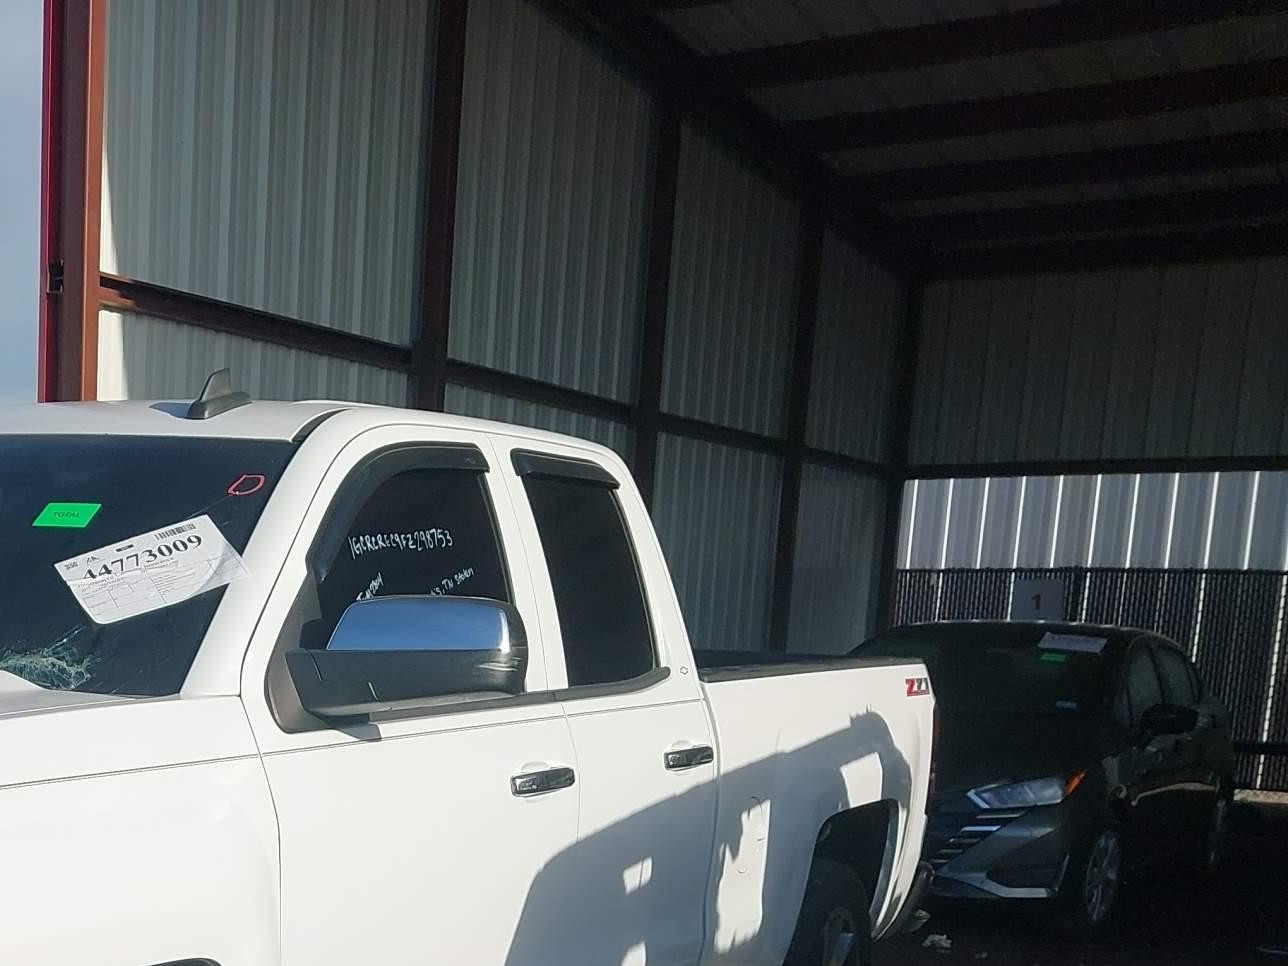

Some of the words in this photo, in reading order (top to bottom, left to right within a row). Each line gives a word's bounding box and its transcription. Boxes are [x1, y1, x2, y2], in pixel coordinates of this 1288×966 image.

[52, 511, 81, 519] TOTAL
[83, 534, 202, 580] 44773009
[1031, 593, 1044, 610] 1
[904, 677, 931, 697] Z71
